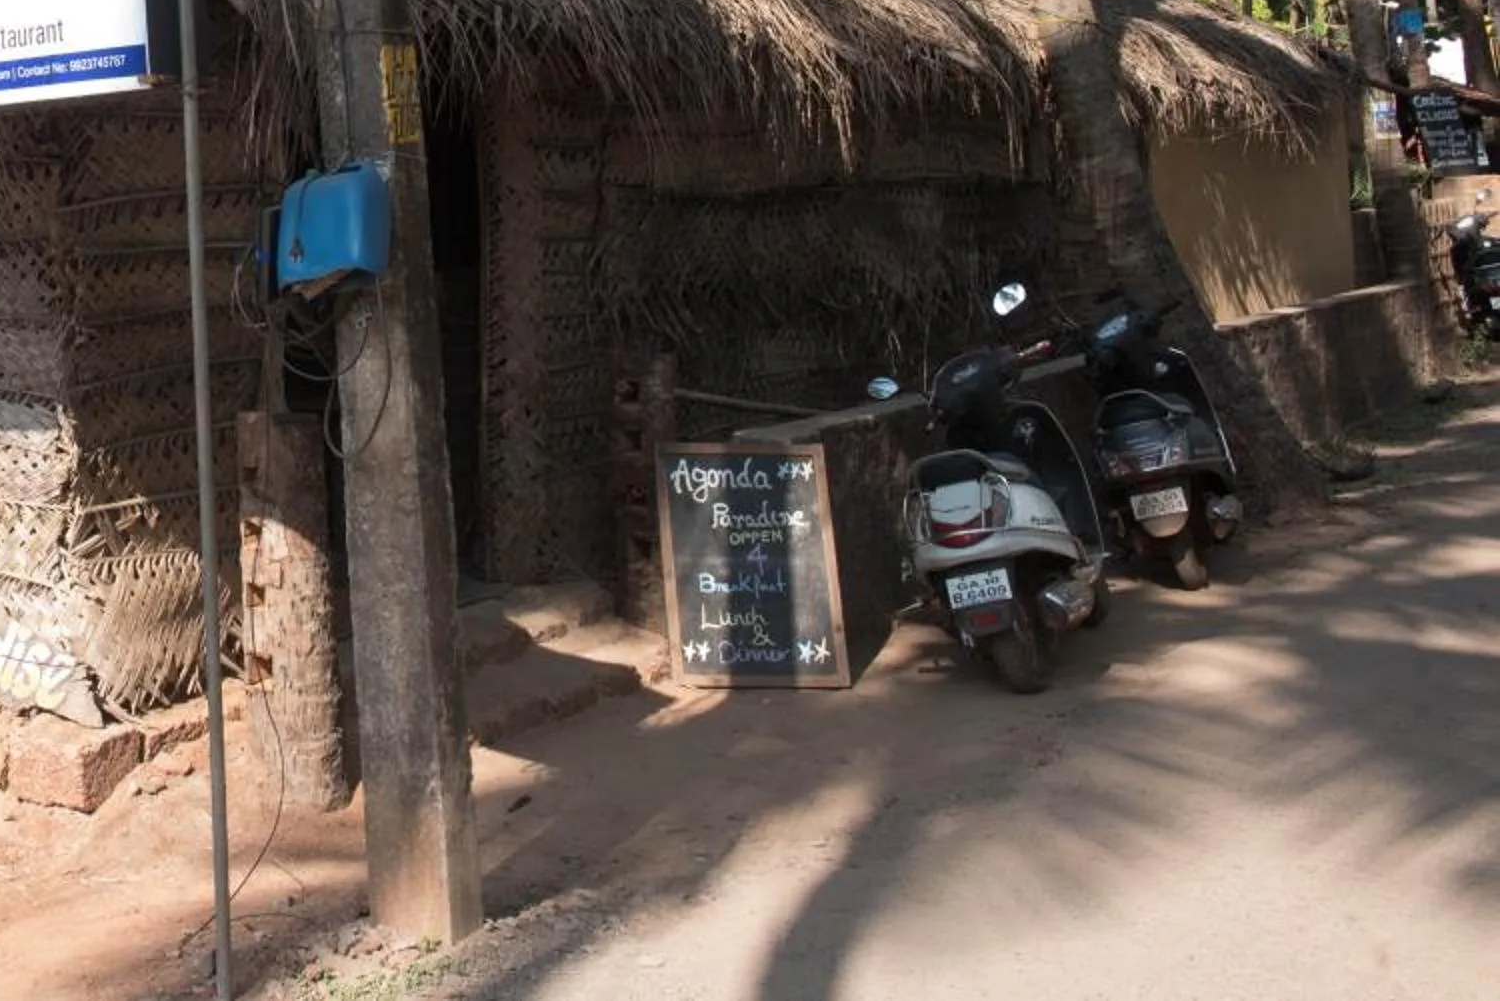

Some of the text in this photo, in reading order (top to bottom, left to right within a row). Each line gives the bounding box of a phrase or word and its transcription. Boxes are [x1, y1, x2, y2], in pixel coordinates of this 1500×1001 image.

[670, 458, 772, 503] Agonda
[700, 602, 770, 631] Lunch
[752, 624, 776, 647] &
[718, 640, 790, 663] Dinner
